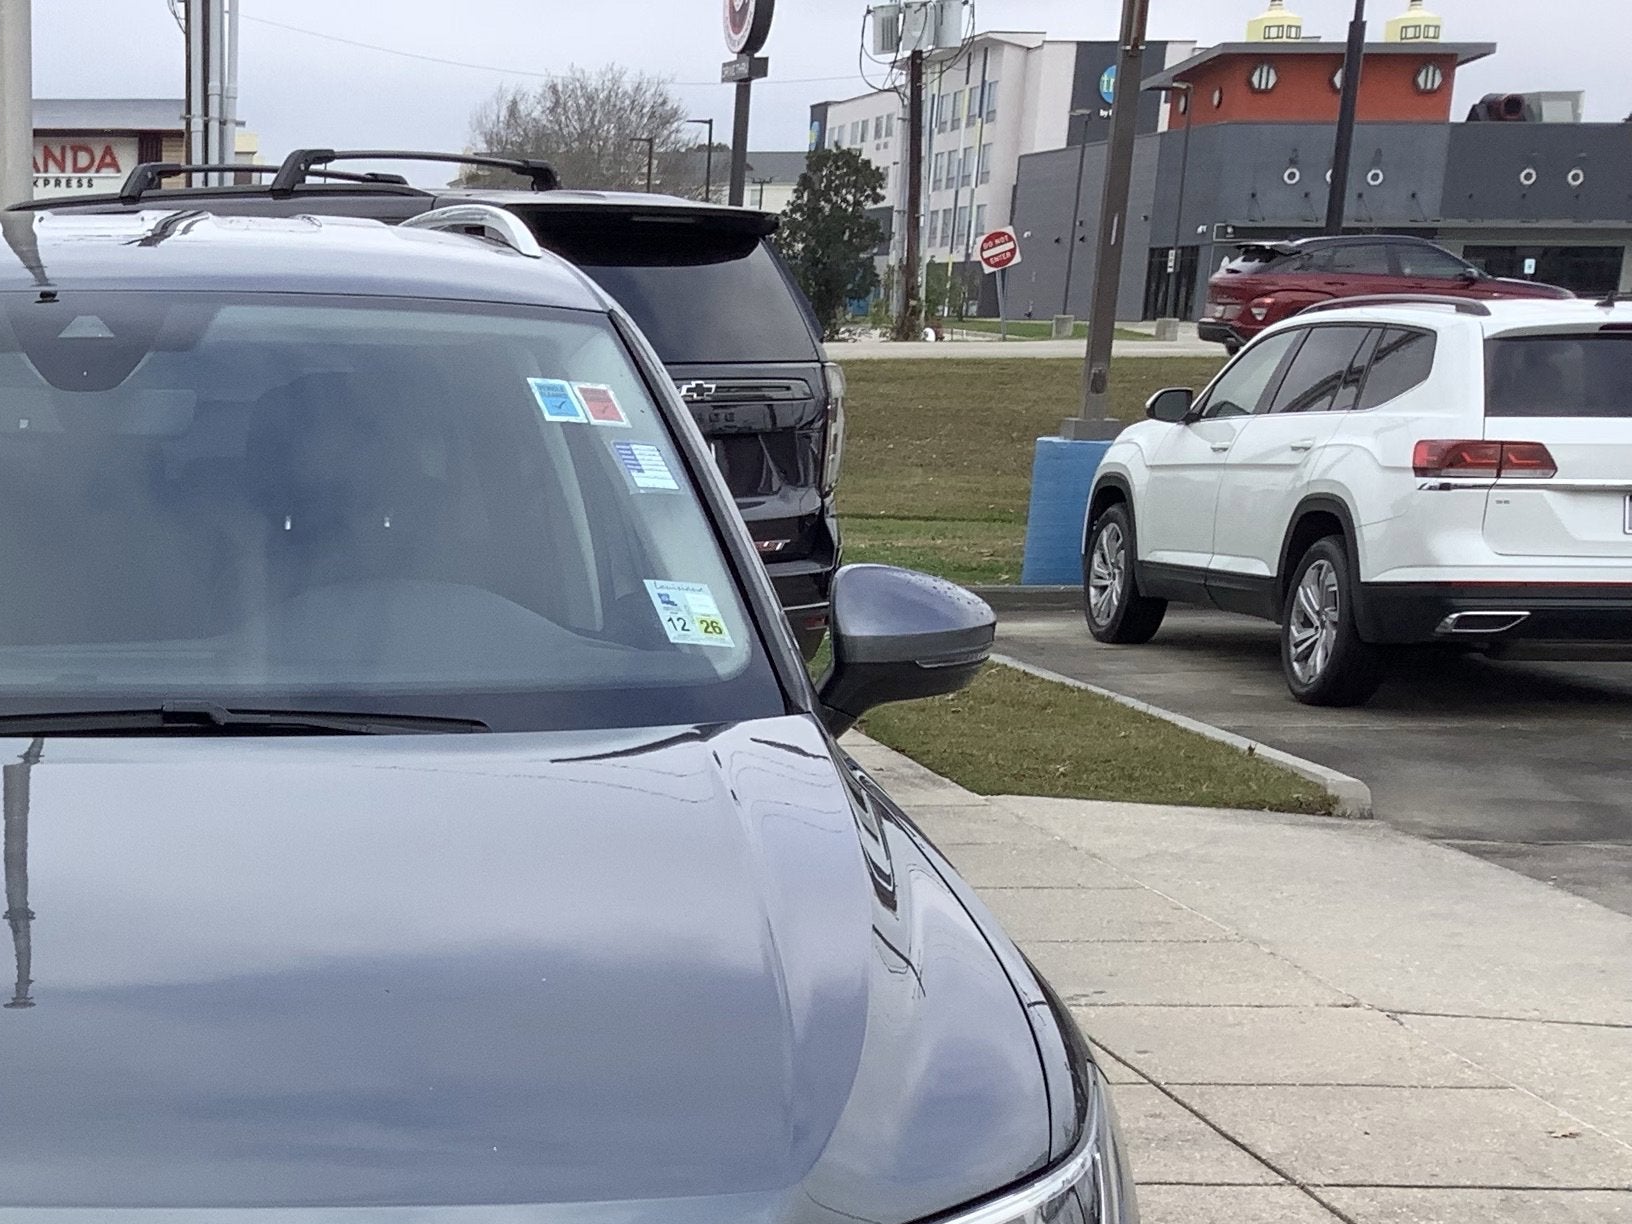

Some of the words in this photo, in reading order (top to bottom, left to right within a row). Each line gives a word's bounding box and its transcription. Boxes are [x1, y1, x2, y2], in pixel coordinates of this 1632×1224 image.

[33, 144, 121, 174] NDA
[33, 177, 94, 189] XPRESS
[983, 241, 993, 250] DO
[995, 235, 1008, 245] NOT
[989, 251, 1011, 264] ENTER
[667, 616, 691, 632] 12
[699, 619, 723, 635] 26
